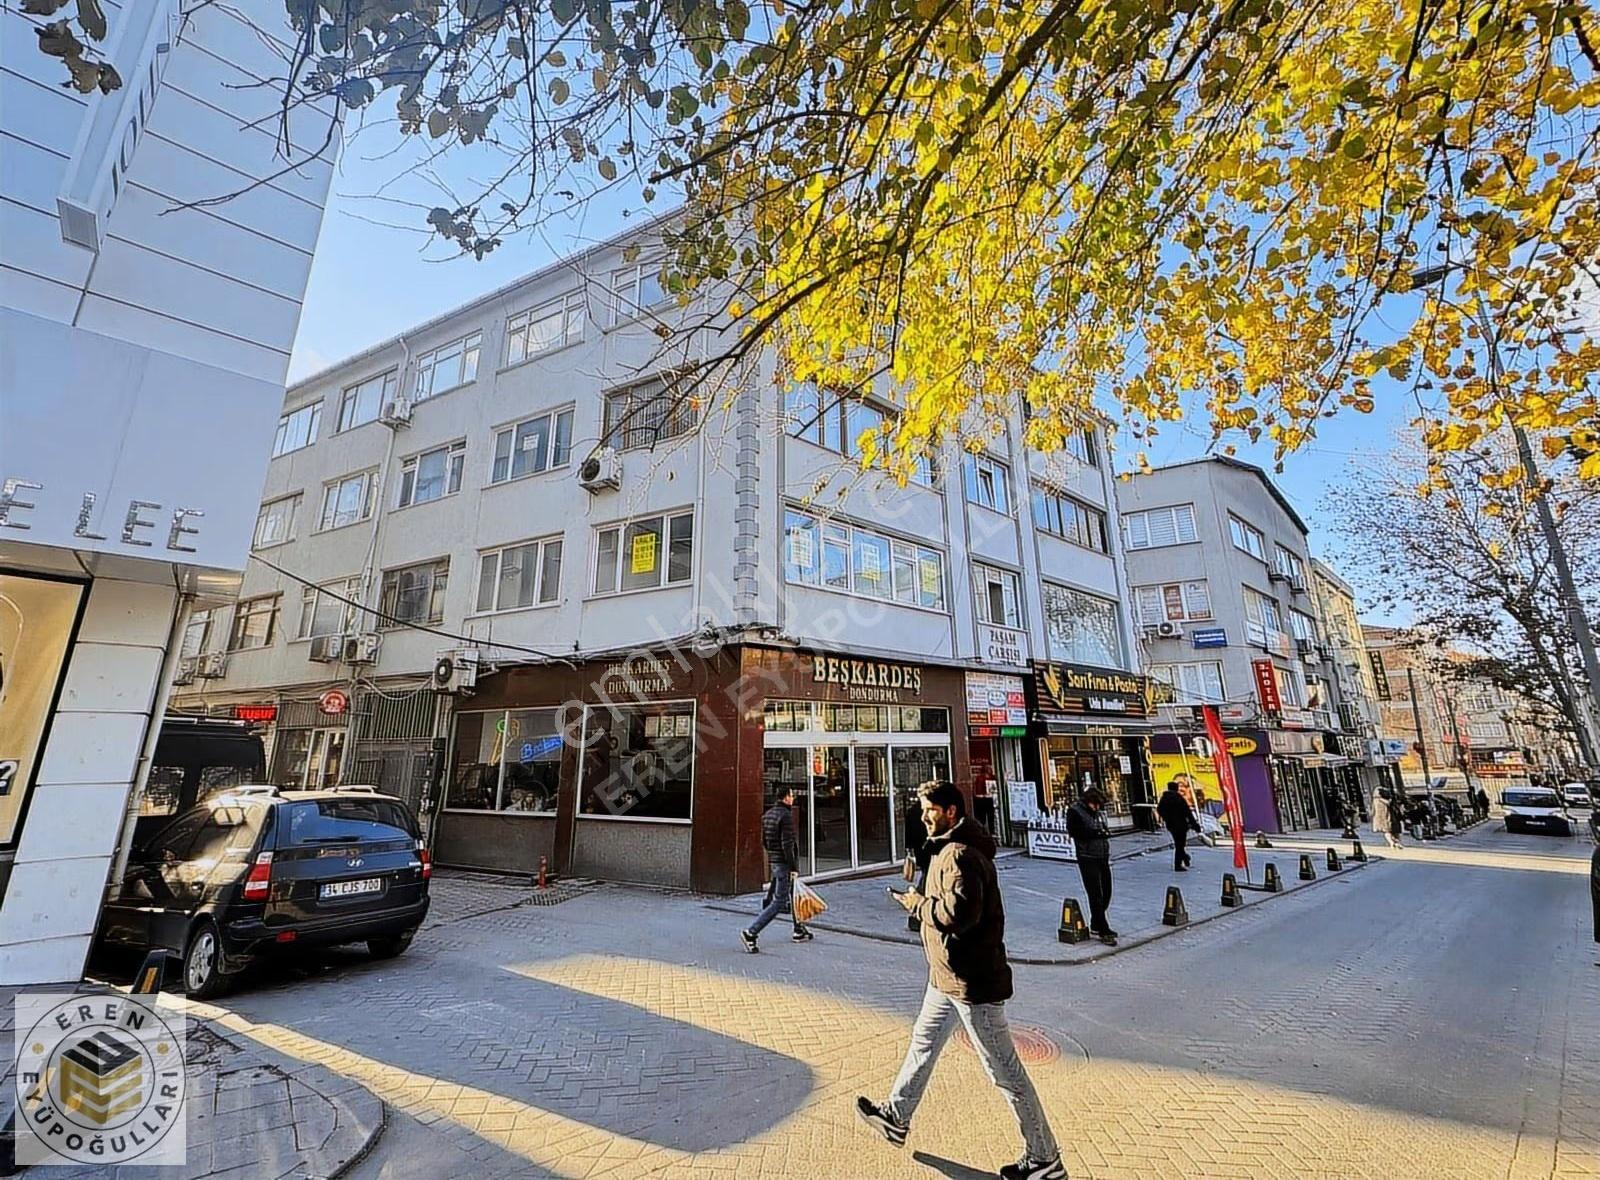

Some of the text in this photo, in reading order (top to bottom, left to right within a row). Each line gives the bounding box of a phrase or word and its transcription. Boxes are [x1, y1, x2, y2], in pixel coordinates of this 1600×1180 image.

[73, 491, 205, 553] LEE
[813, 656, 921, 695] BEŞKARDEŞ
[1114, 675, 1138, 694] Pasta
[849, 687, 898, 702] DONDURMA
[1261, 671, 1276, 710] NOTER
[1034, 833, 1072, 845] AVON
[325, 883, 337, 896] 34
[363, 878, 379, 890] 700
